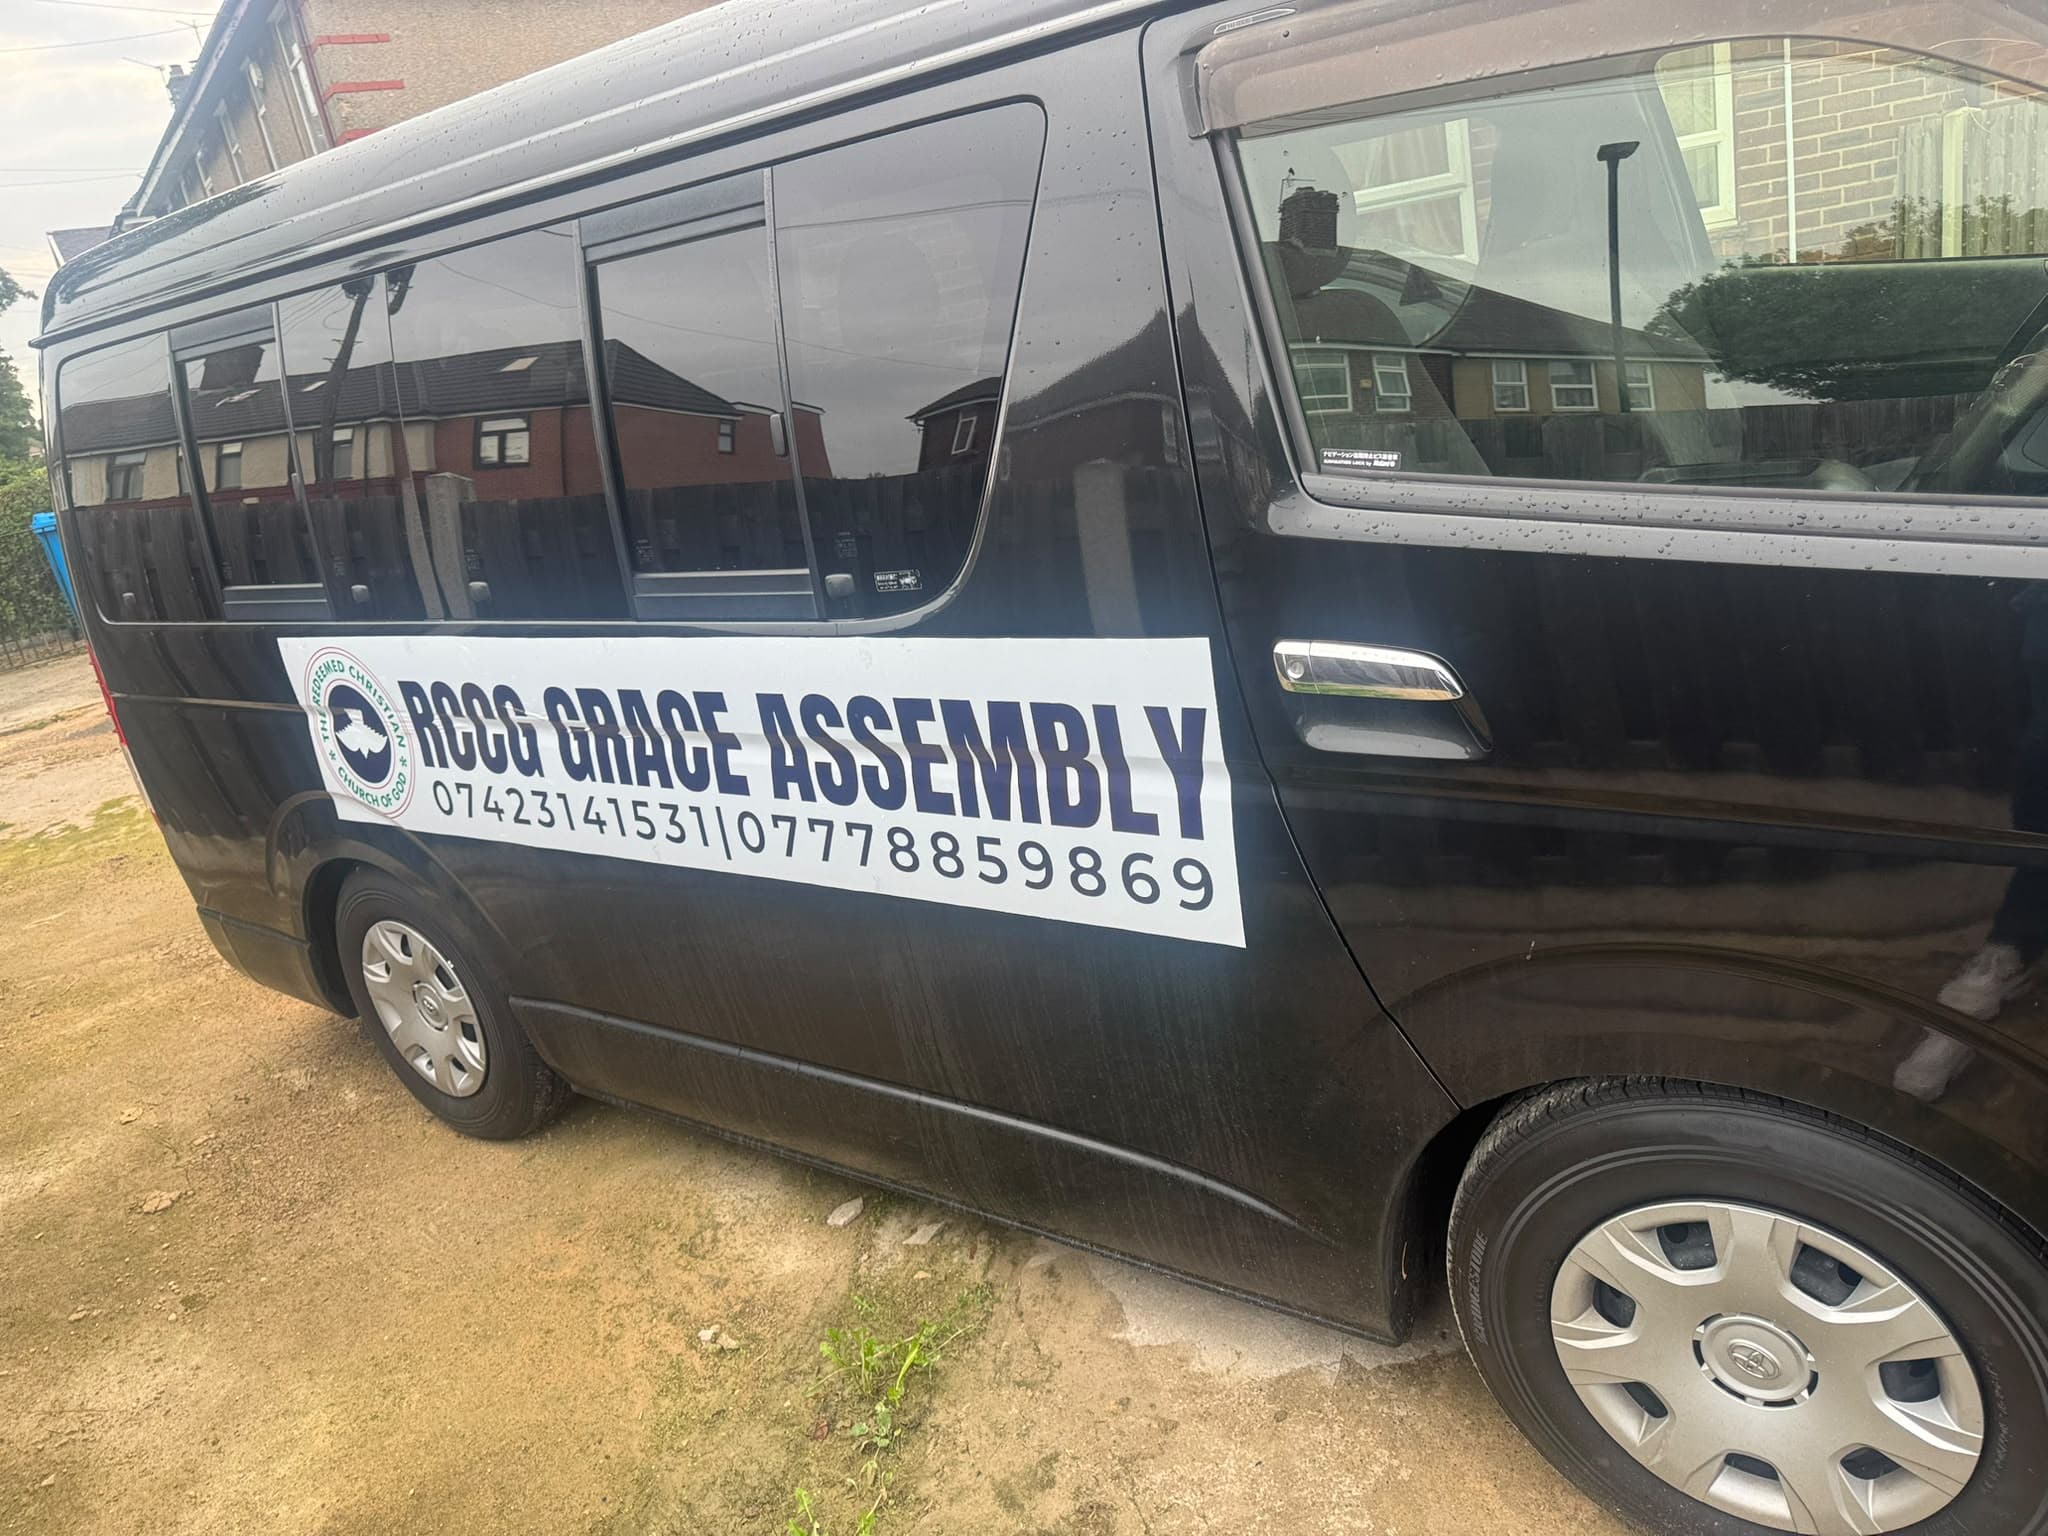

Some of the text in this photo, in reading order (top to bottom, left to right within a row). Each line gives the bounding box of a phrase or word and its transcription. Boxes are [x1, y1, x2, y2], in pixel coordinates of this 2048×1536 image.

[312, 660, 344, 706] REDEEMED
[349, 666, 406, 748] CHRISTIAN
[338, 767, 407, 808] CHURCH OF GOD
[398, 680, 1207, 841] RCCG GRACE ASSEMBLY
